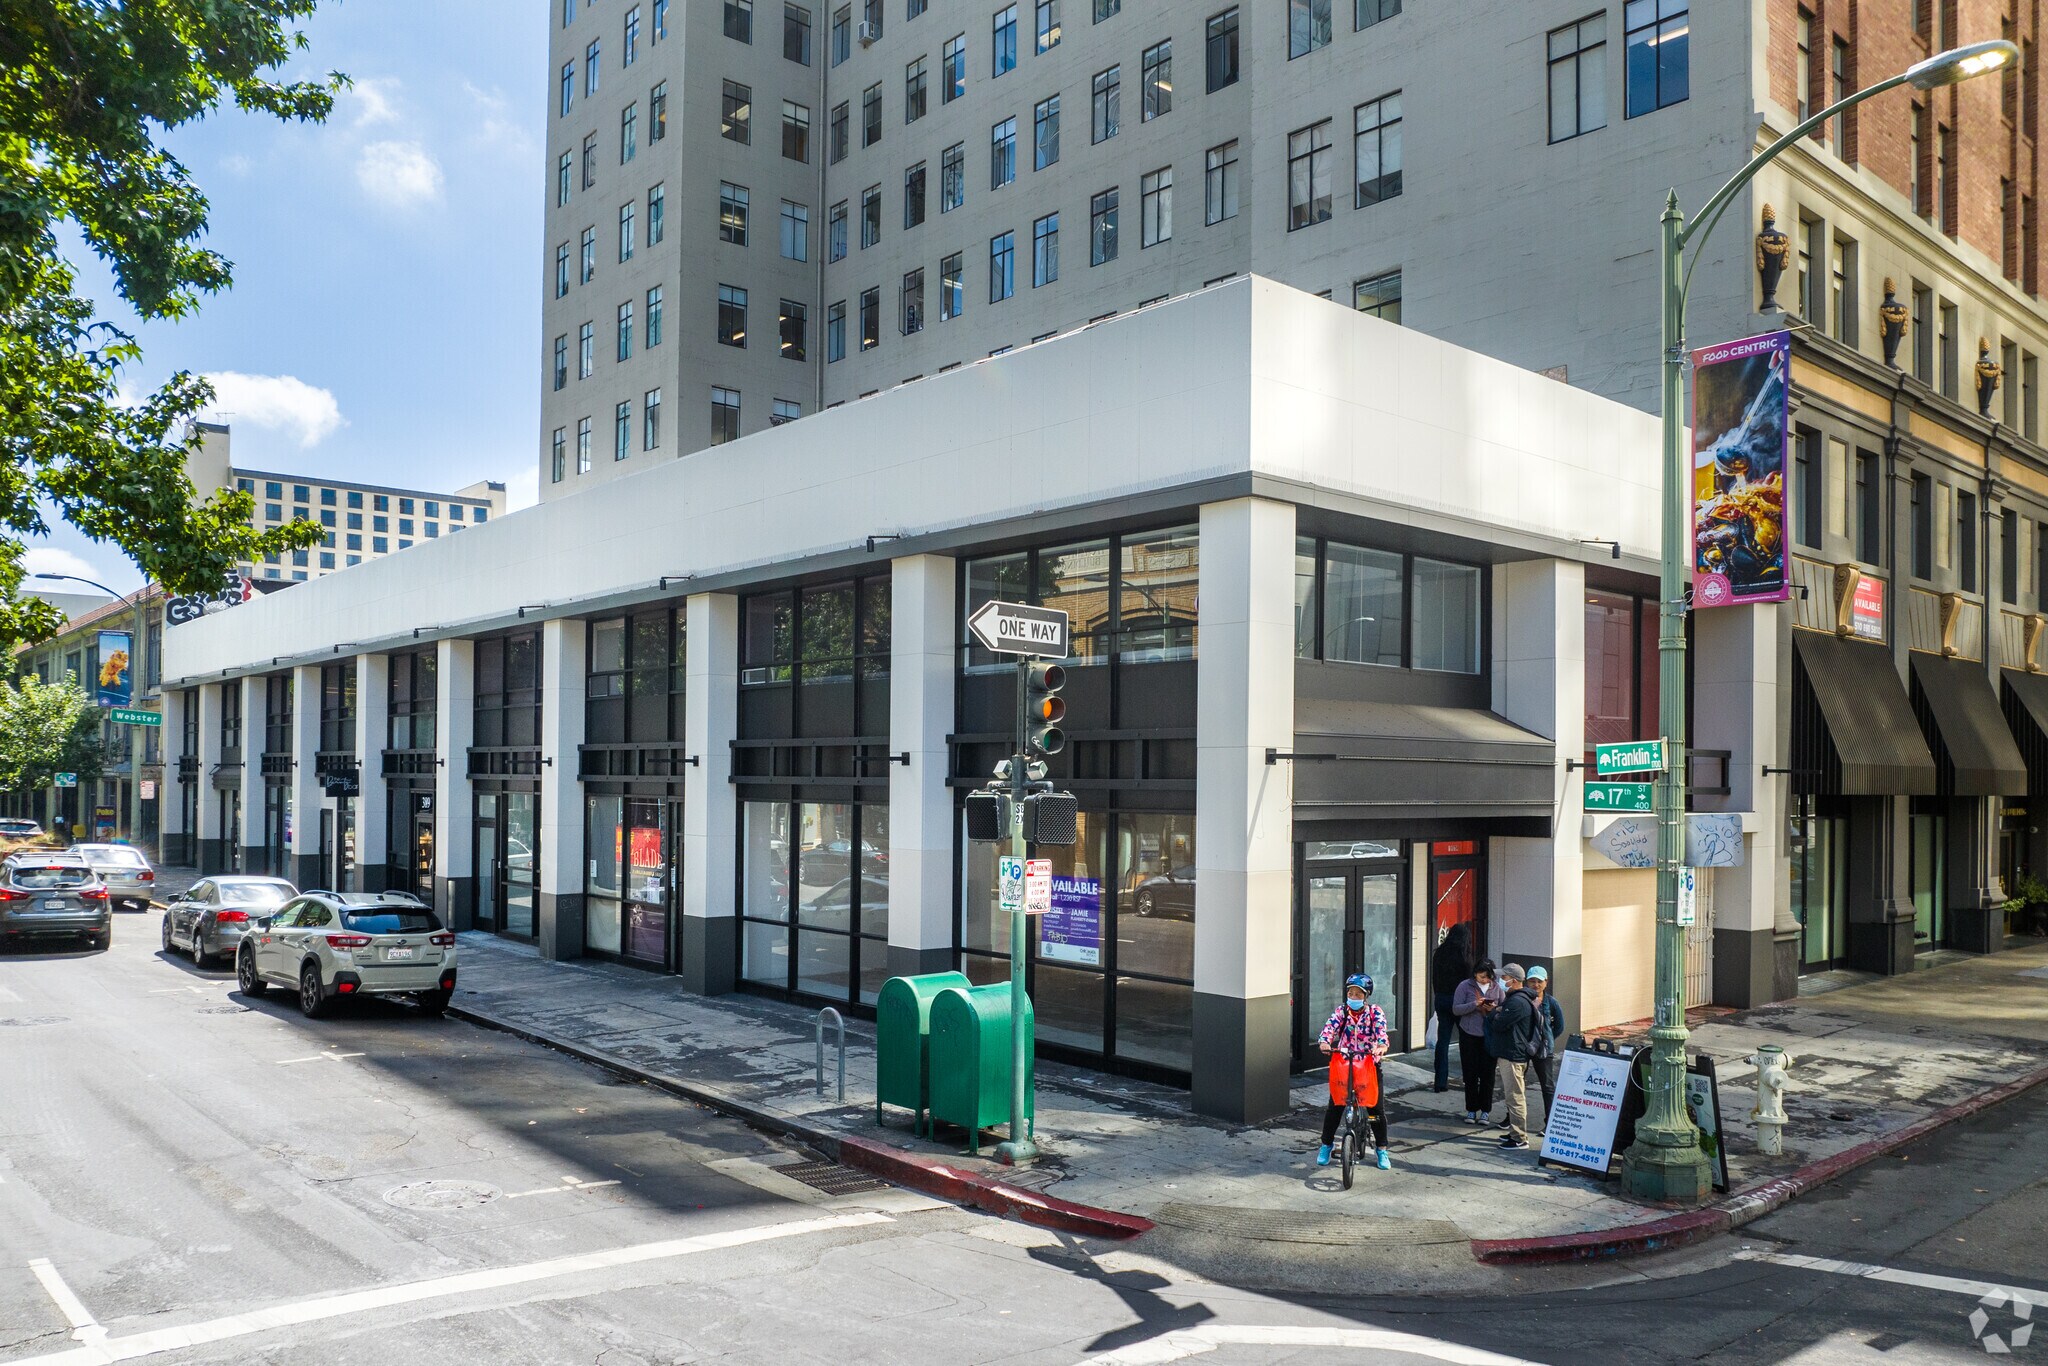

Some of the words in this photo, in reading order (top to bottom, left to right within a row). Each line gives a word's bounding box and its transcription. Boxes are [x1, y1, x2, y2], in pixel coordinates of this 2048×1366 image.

[1703, 350, 1729, 362] FOOD
[1730, 339, 1778, 355] CENTRIC
[1854, 598, 1880, 612] AVAILABLE
[1000, 619, 1025, 637] ONE
[1031, 622, 1056, 640] WAY
[116, 712, 158, 722] Webster
[1611, 747, 1650, 767] Franklin
[1608, 788, 1631, 805] 17th
[633, 848, 662, 869] BLADE
[1052, 880, 1097, 895] VAILABLE
[1586, 1074, 1617, 1088] Active
[1557, 1094, 1582, 1104] ACCEPTING
[1593, 1101, 1617, 1111] PATIENTS!
[1583, 1089, 1614, 1101] CHIROPRACTIC
[1549, 1137, 1559, 1145] 1624
[1560, 1140, 1577, 1149] Franklin
[1585, 1145, 1596, 1153] Suite
[1550, 1147, 1600, 1164] 510-817-4515
